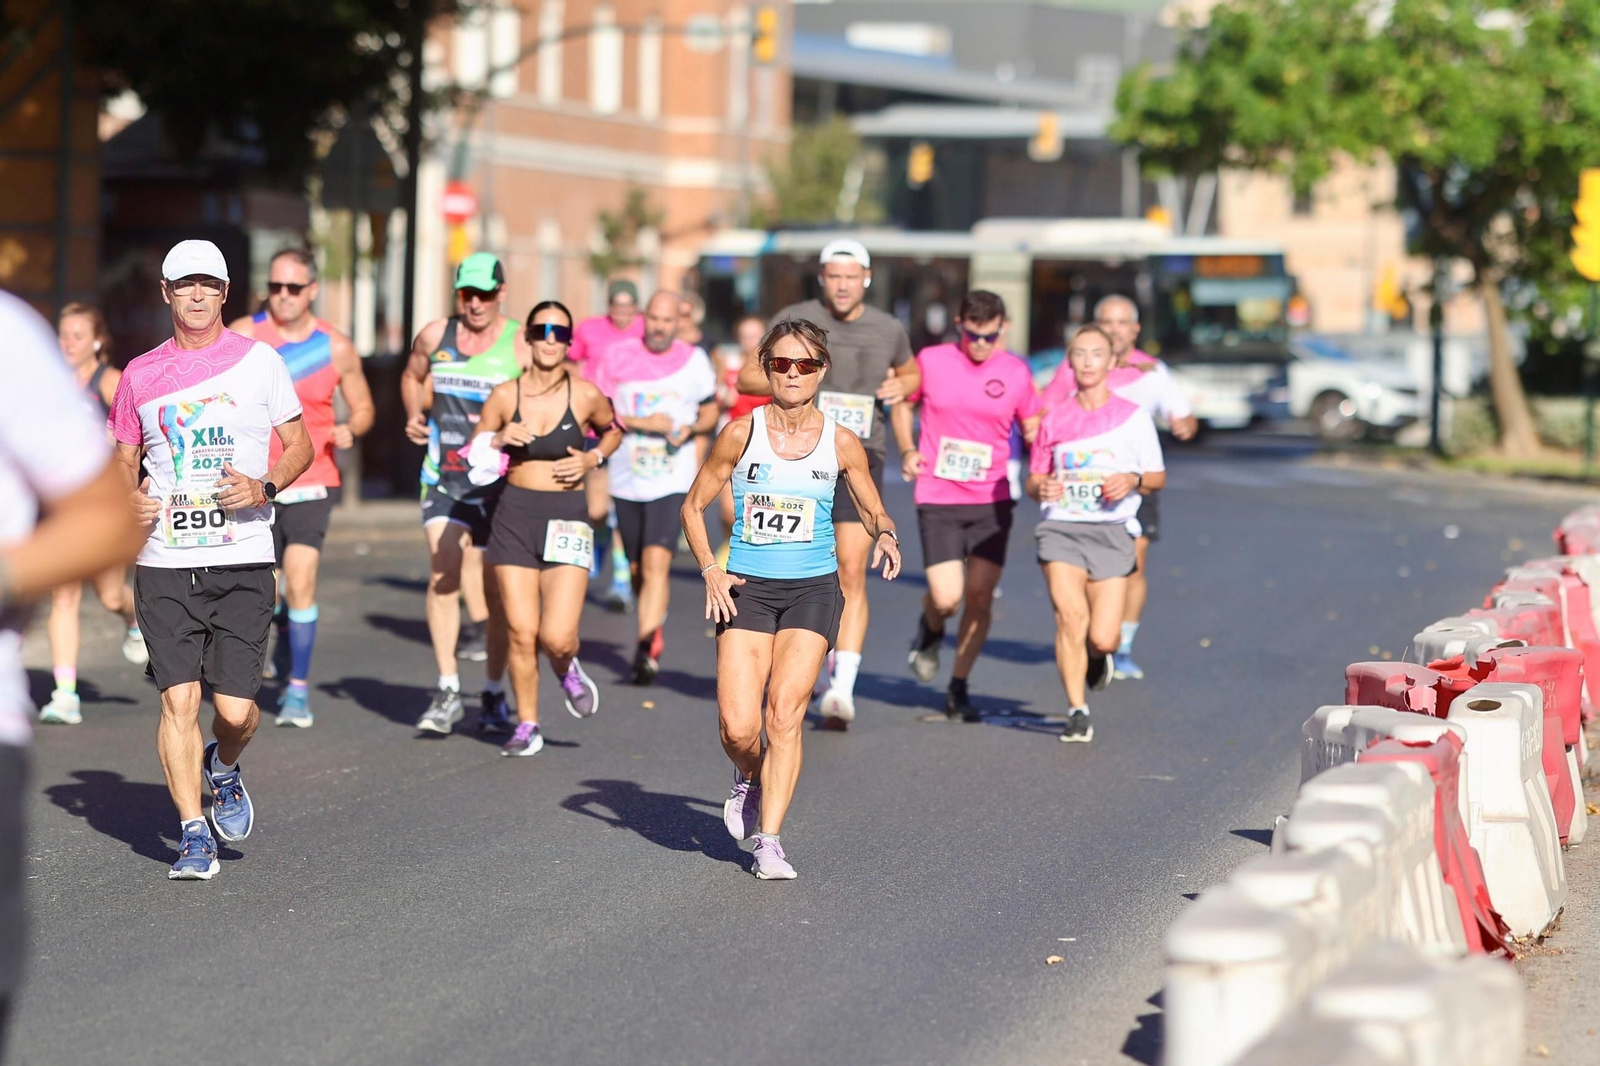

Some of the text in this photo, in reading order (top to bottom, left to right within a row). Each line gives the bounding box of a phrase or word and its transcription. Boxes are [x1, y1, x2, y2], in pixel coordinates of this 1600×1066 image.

[213, 435, 235, 446] 10k
[746, 463, 772, 481] CS
[1066, 484, 1104, 499] 160
[780, 502, 804, 511] 2025
[172, 509, 226, 530] 290
[753, 511, 801, 534] 147
